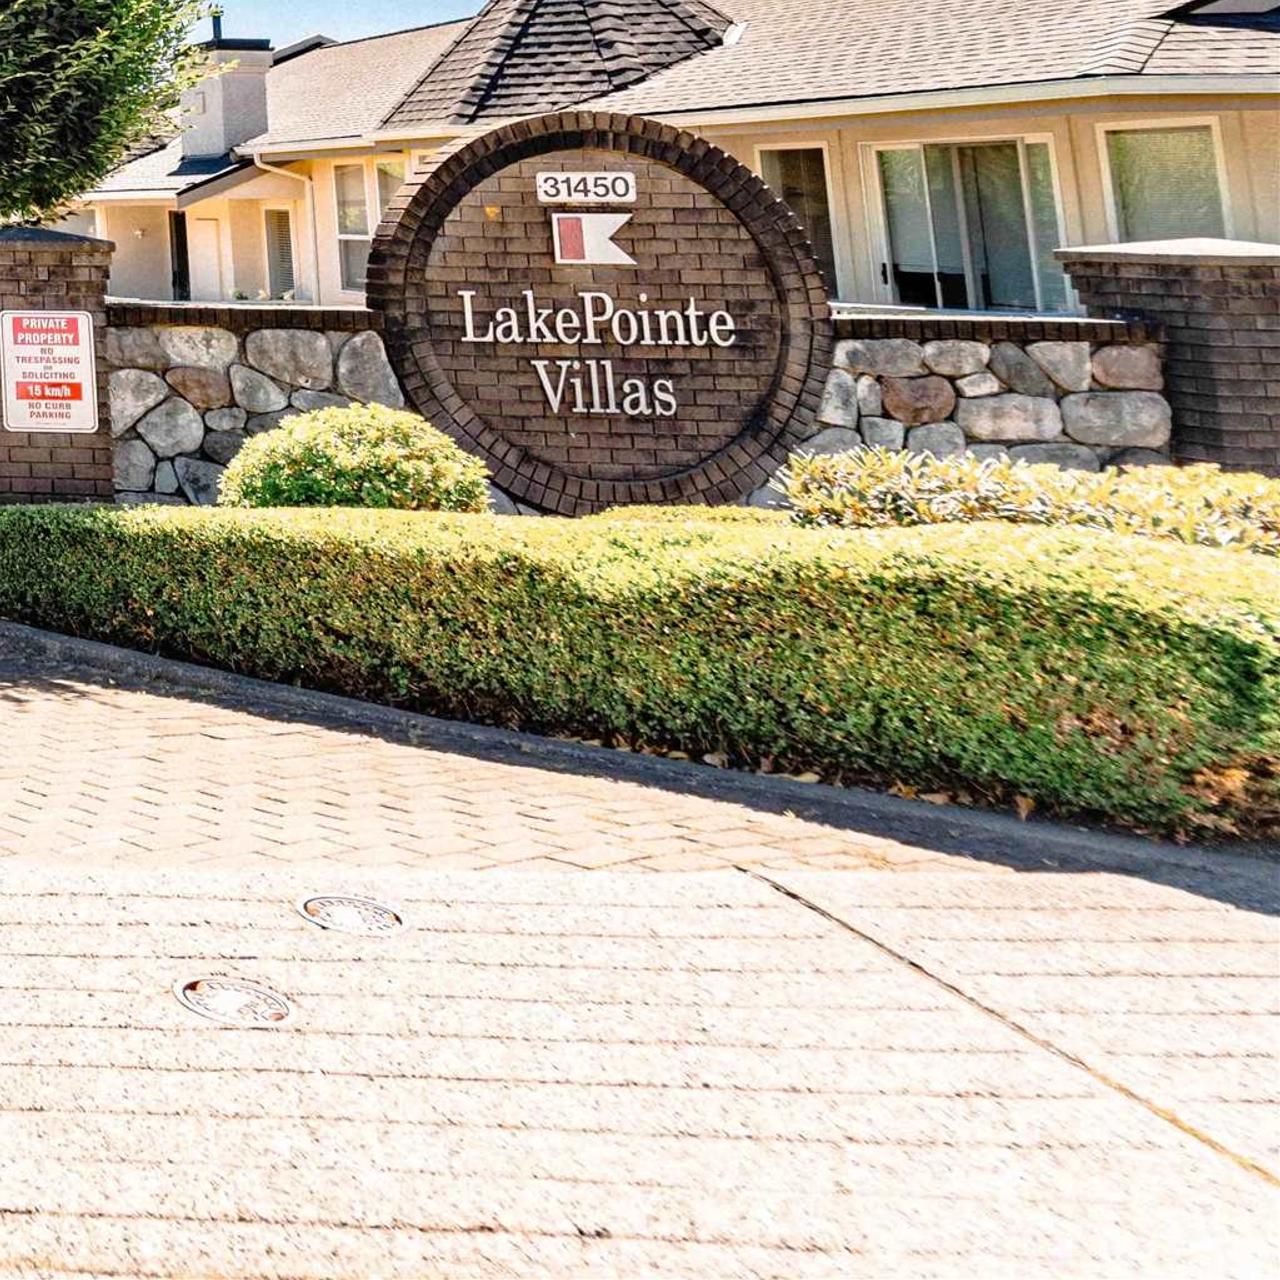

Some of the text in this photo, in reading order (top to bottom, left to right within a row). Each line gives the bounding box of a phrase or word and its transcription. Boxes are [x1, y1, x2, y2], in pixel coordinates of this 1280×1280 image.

[542, 176, 630, 198] 31450
[457, 290, 737, 346] LakePointe
[22, 319, 68, 329] PRIVATE
[17, 333, 74, 344] PROPERTY
[16, 356, 80, 364] TRESPASSING
[22, 371, 76, 380] SOLICITING
[28, 385, 41, 396] 15
[531, 360, 677, 416] Villas
[28, 402, 72, 410] NO CURB
[29, 411, 71, 419] PARKING
